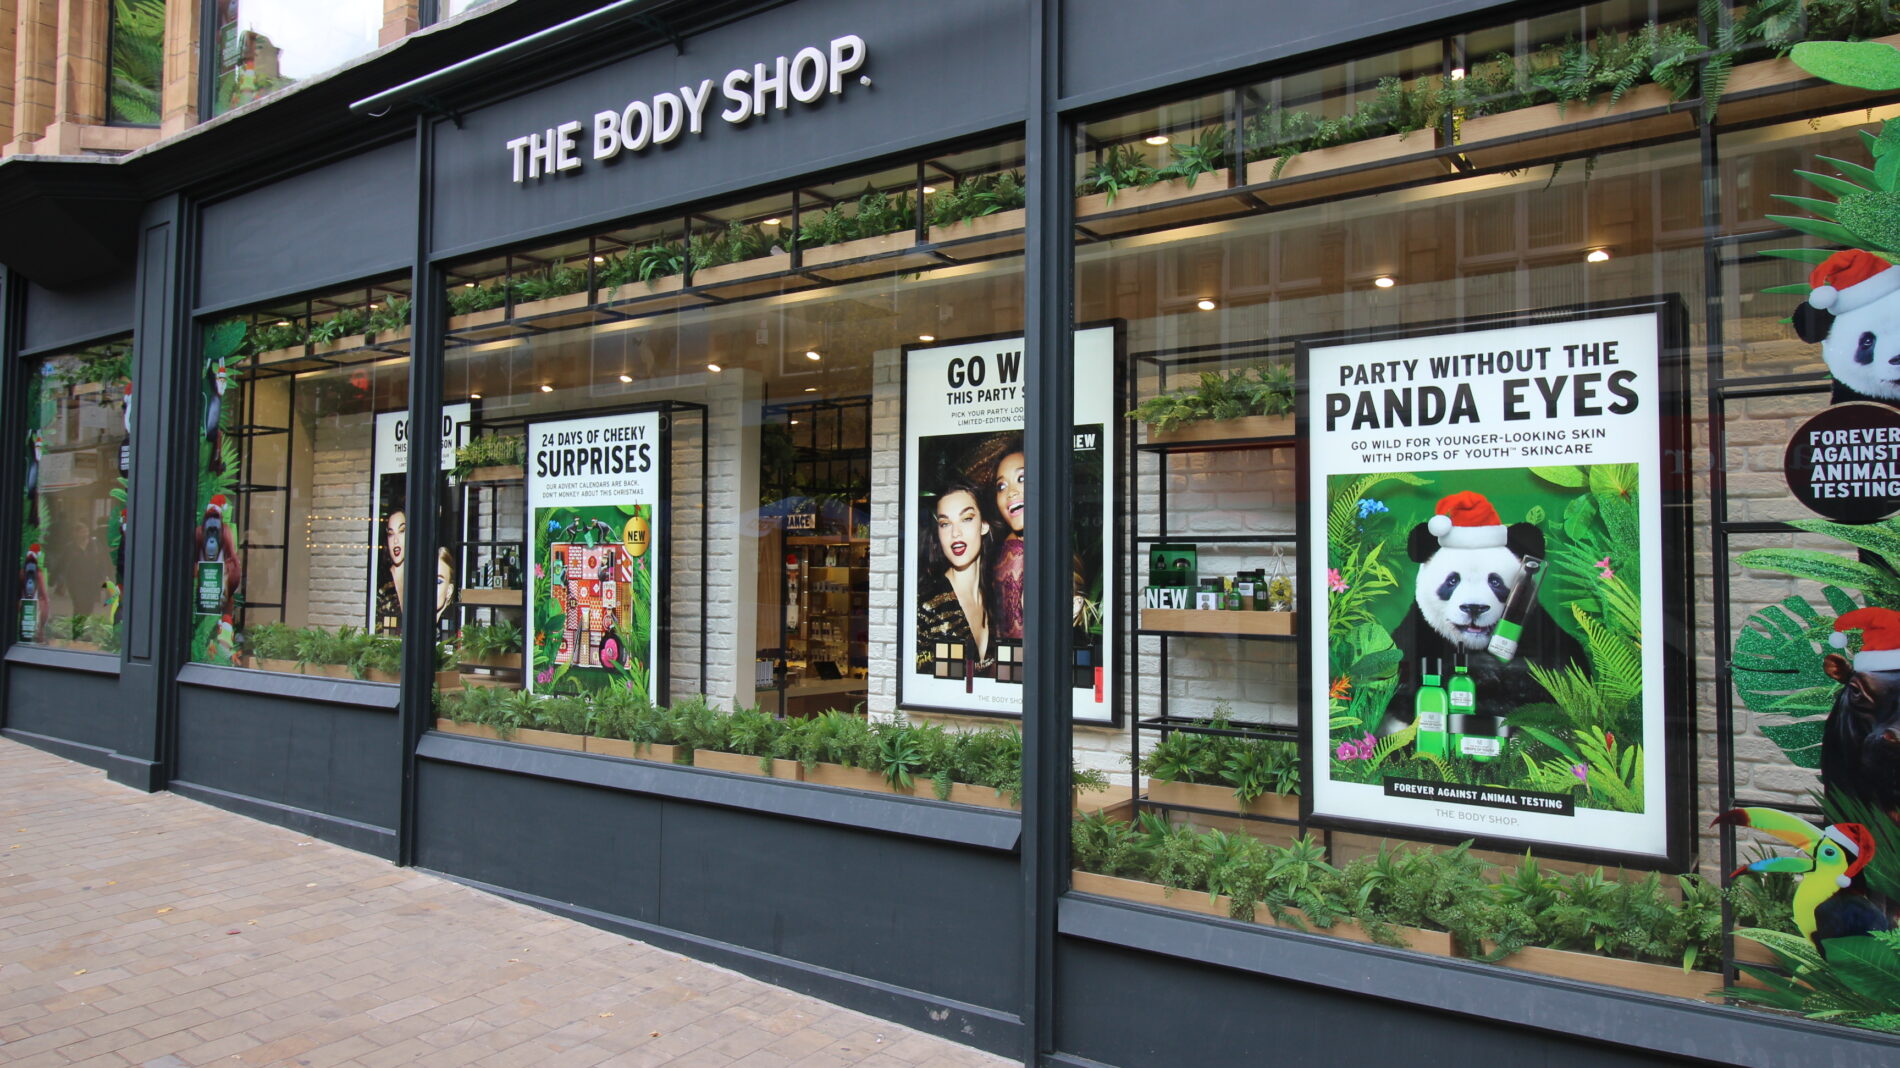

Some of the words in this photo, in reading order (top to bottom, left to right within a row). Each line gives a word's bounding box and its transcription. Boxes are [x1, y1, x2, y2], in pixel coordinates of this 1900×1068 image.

[507, 120, 582, 183] THE
[593, 79, 715, 161] BODY
[721, 34, 872, 124] SHOP.
[947, 355, 986, 388] GO
[1340, 359, 1419, 386] PARTY
[1429, 347, 1551, 379] WITHOUT
[1563, 341, 1619, 368] THE
[947, 390, 973, 405] THIS
[978, 386, 1017, 403] PARTY
[1326, 383, 1480, 432] PANDA
[1502, 369, 1640, 422] EYES
[957, 416, 1011, 426] LIMITED-EDITION
[967, 409, 985, 417] YOUR
[986, 407, 1009, 415] PARTY
[542, 433, 555, 448] 24
[558, 430, 583, 446] DAYS
[586, 429, 600, 444] OF
[603, 425, 646, 443] CHEEKY
[1073, 433, 1096, 448] EW
[1351, 440, 1368, 451] GO
[1372, 439, 1402, 449] WILD
[1406, 437, 1431, 448] FOR
[1436, 430, 1566, 446] YOUNGER-LOOKING
[1572, 428, 1606, 440] SKIN
[1809, 427, 1900, 446] FOREVER
[394, 443, 407, 453] THIS
[1362, 453, 1392, 463] WITH
[1396, 451, 1439, 462] DROPS
[1443, 449, 1460, 460] OF
[1521, 443, 1593, 456] SKINCARE
[1810, 444, 1900, 463] AGAINST
[536, 443, 651, 478] SURPRISES
[1810, 462, 1900, 482] ANIMAL
[542, 491, 557, 499] DON'T
[558, 490, 580, 498] MONKEY
[581, 489, 599, 498] ABOUT
[600, 489, 612, 497] THIS
[613, 488, 644, 496] CHRISTMAS
[558, 482, 578, 490] ADVENT
[579, 481, 610, 489] CALENDARS
[611, 480, 622, 488] ARE
[1810, 480, 1900, 499] TESTING
[627, 530, 646, 541] NEW
[1146, 588, 1188, 609] NEW
[977, 695, 990, 703] THE
[991, 696, 1008, 704] BODY
[1393, 782, 1435, 796] FOREVER
[1437, 787, 1477, 800] AGAINST
[1480, 792, 1518, 805] ANIMAL
[1521, 796, 1563, 809] TESTING
[1435, 808, 1454, 819] THE
[1458, 811, 1487, 823] BODY
[1489, 815, 1520, 826] SHOP.
